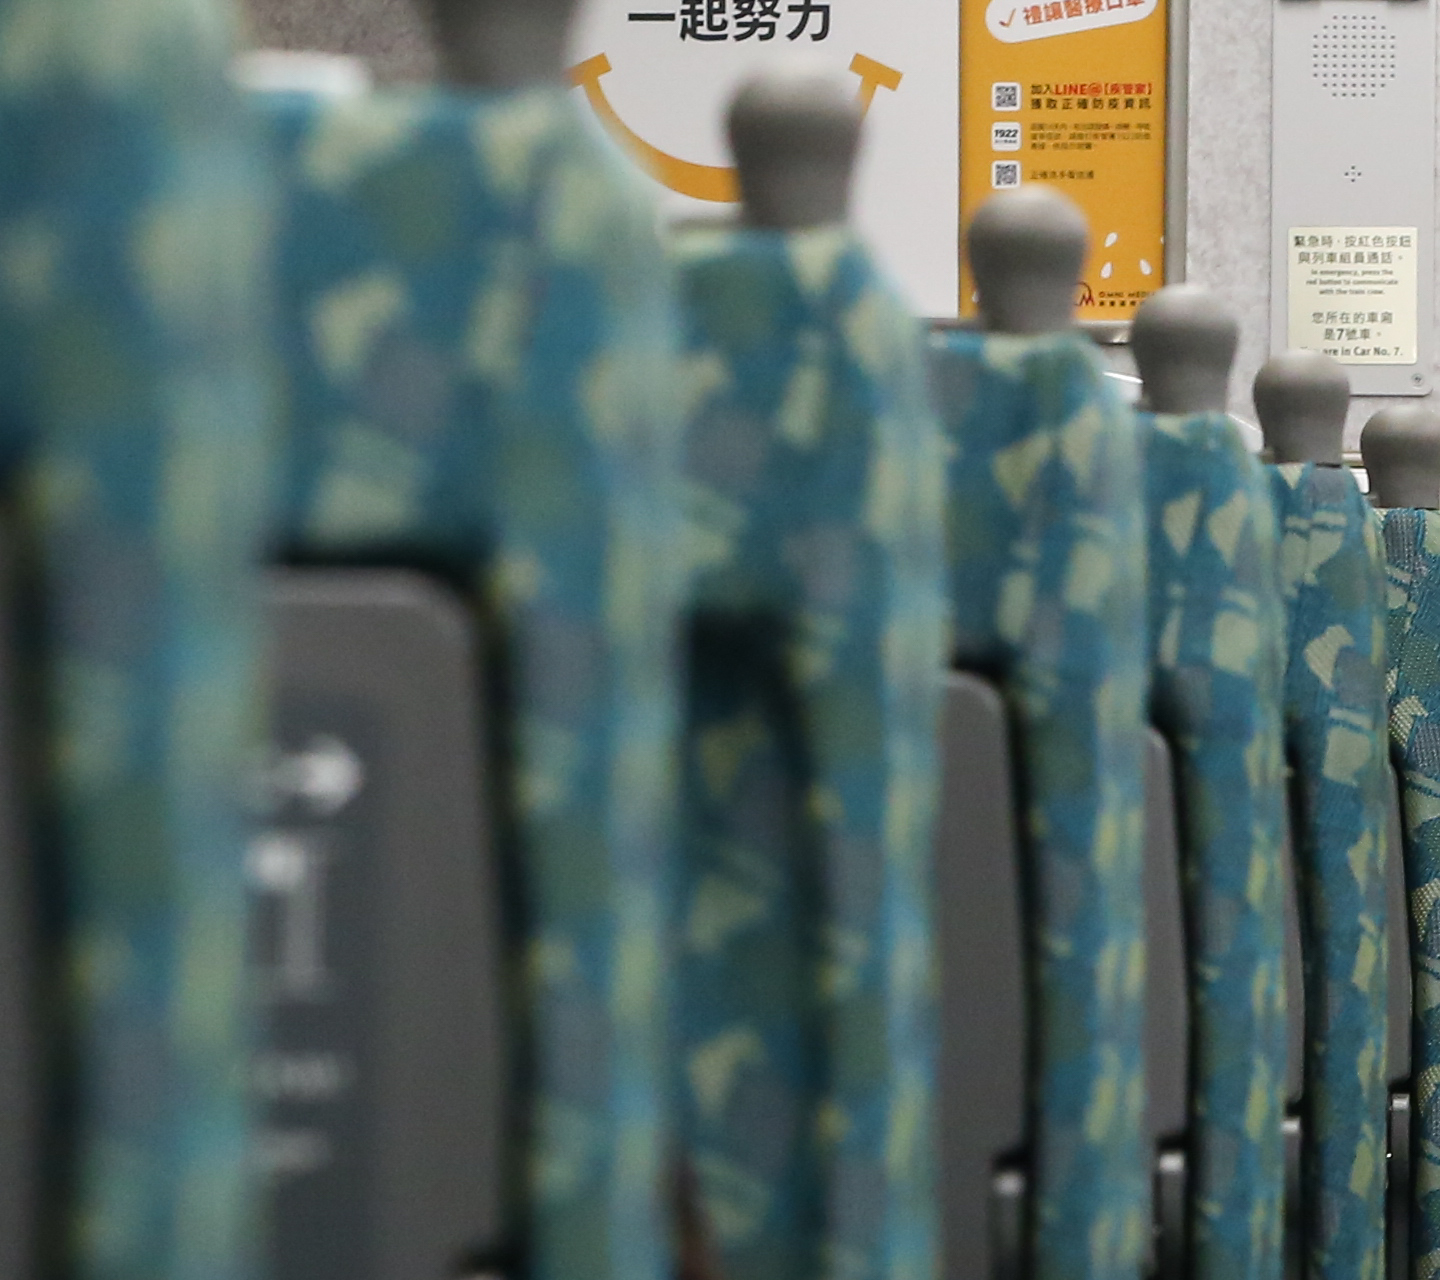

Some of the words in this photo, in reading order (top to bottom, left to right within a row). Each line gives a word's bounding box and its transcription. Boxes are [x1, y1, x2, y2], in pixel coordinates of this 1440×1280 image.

[994, 128, 1019, 139] 1922
[1341, 346, 1351, 357] in
[1353, 347, 1371, 357] Car
[1373, 347, 1390, 357] No.
